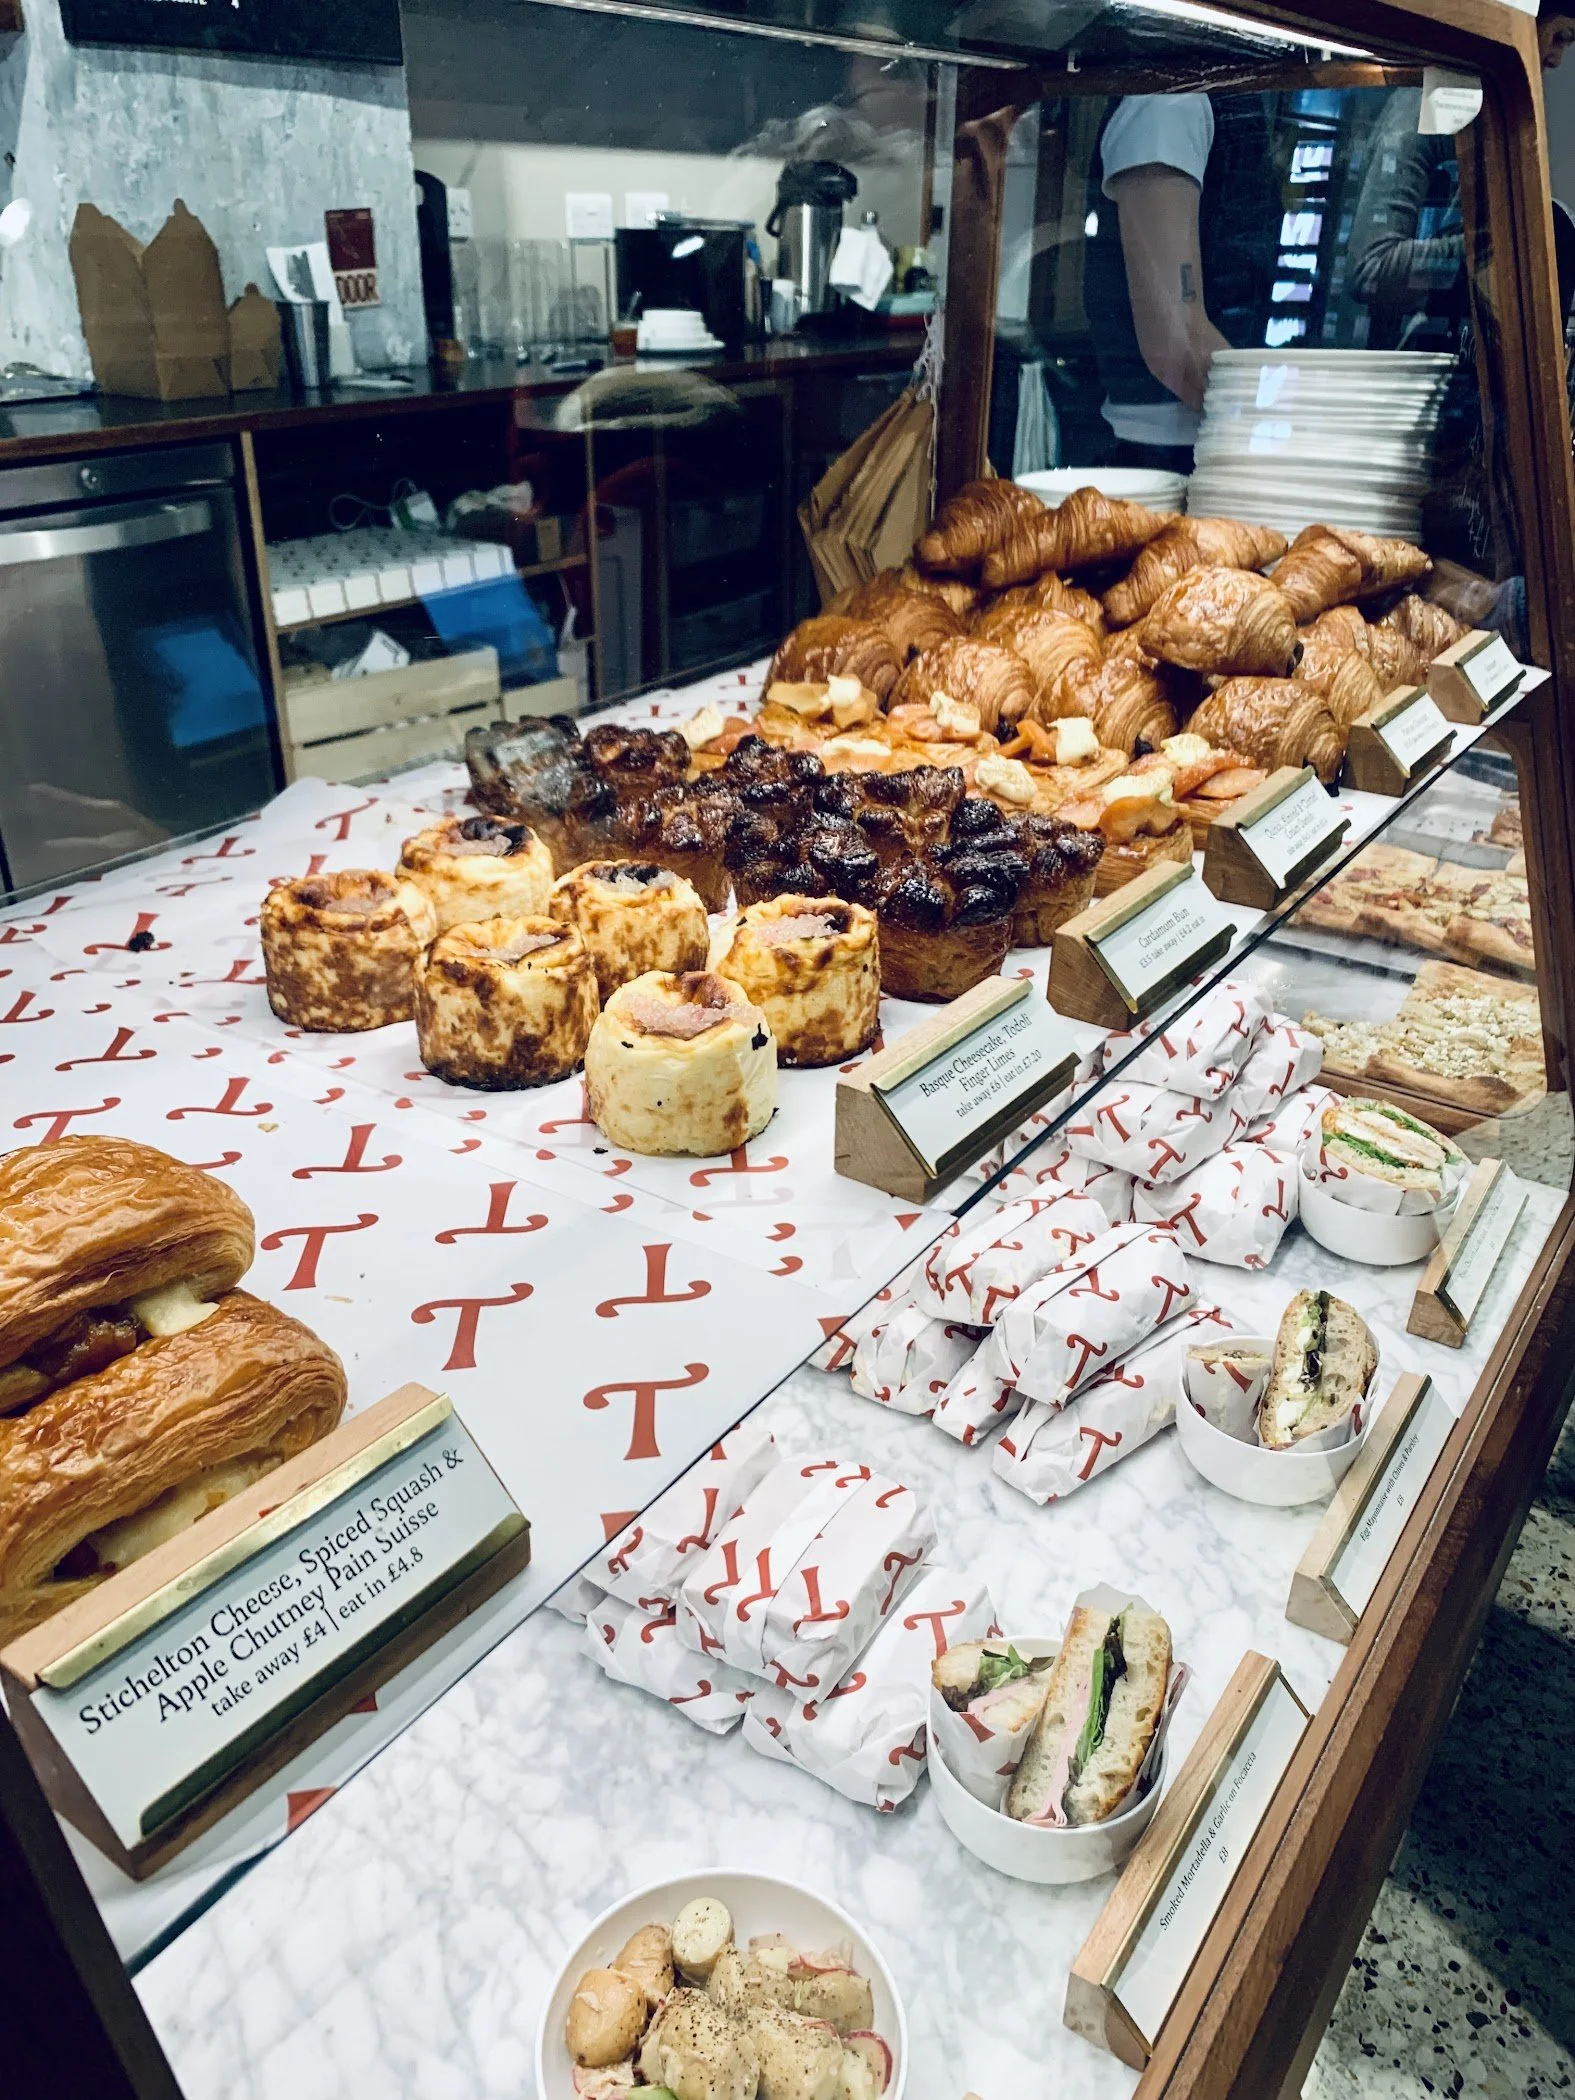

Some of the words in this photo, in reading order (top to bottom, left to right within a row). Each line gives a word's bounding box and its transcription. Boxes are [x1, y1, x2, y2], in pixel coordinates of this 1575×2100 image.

[1138, 919, 1175, 949] Cardamom
[1172, 908, 1190, 923] Bun
[1151, 947, 1164, 961] take
[1164, 938, 1178, 953] away
[919, 1069, 955, 1098] Basque
[952, 1036, 1007, 1074] Cheesecake,
[955, 1102, 974, 1118] take
[973, 1088, 993, 1106] away
[990, 1081, 1001, 1093] £6
[1014, 1063, 1025, 1075] in
[1021, 1049, 1043, 1070] £7.20
[958, 1066, 990, 1092] Finger
[986, 1048, 1016, 1072] Limes
[291, 1122, 404, 1180] T
[434, 1180, 550, 1245] T
[260, 1213, 380, 1292] T
[595, 1243, 712, 1318] T
[411, 1282, 535, 1372] T
[583, 1362, 711, 1461] T
[1079, 1426, 1123, 1482] T
[1359, 1531, 1371, 1543] Egg
[1366, 1493, 1389, 1530] Mayonnaise
[1385, 1477, 1396, 1495] with
[1391, 1461, 1407, 1483] Chives
[1403, 1433, 1419, 1457] Parsley
[79, 1635, 211, 1736] Stichelton
[209, 1578, 303, 1638] Cheese,
[298, 1509, 373, 1574] Spiced
[369, 1462, 443, 1521] Squash
[442, 1447, 465, 1469] &
[155, 1656, 230, 1723] Apple
[230, 1586, 326, 1660] Chutney
[325, 1548, 378, 1592] Pain
[378, 1500, 440, 1555] Suisse
[211, 1679, 254, 1717] take
[255, 1642, 303, 1686] away
[303, 1620, 329, 1648] £4
[338, 1592, 368, 1622] eat
[368, 1575, 388, 1601] in
[387, 1545, 425, 1587] £4.8
[1159, 1883, 1186, 1931] Smoked
[1179, 1835, 1213, 1892] Mortadella
[1208, 1827, 1217, 1840] &
[1213, 1801, 1232, 1831] Garlic
[1227, 1791, 1237, 1804] on
[1233, 1751, 1258, 1794] Focaccia
[1218, 1845, 1230, 1865] £8
